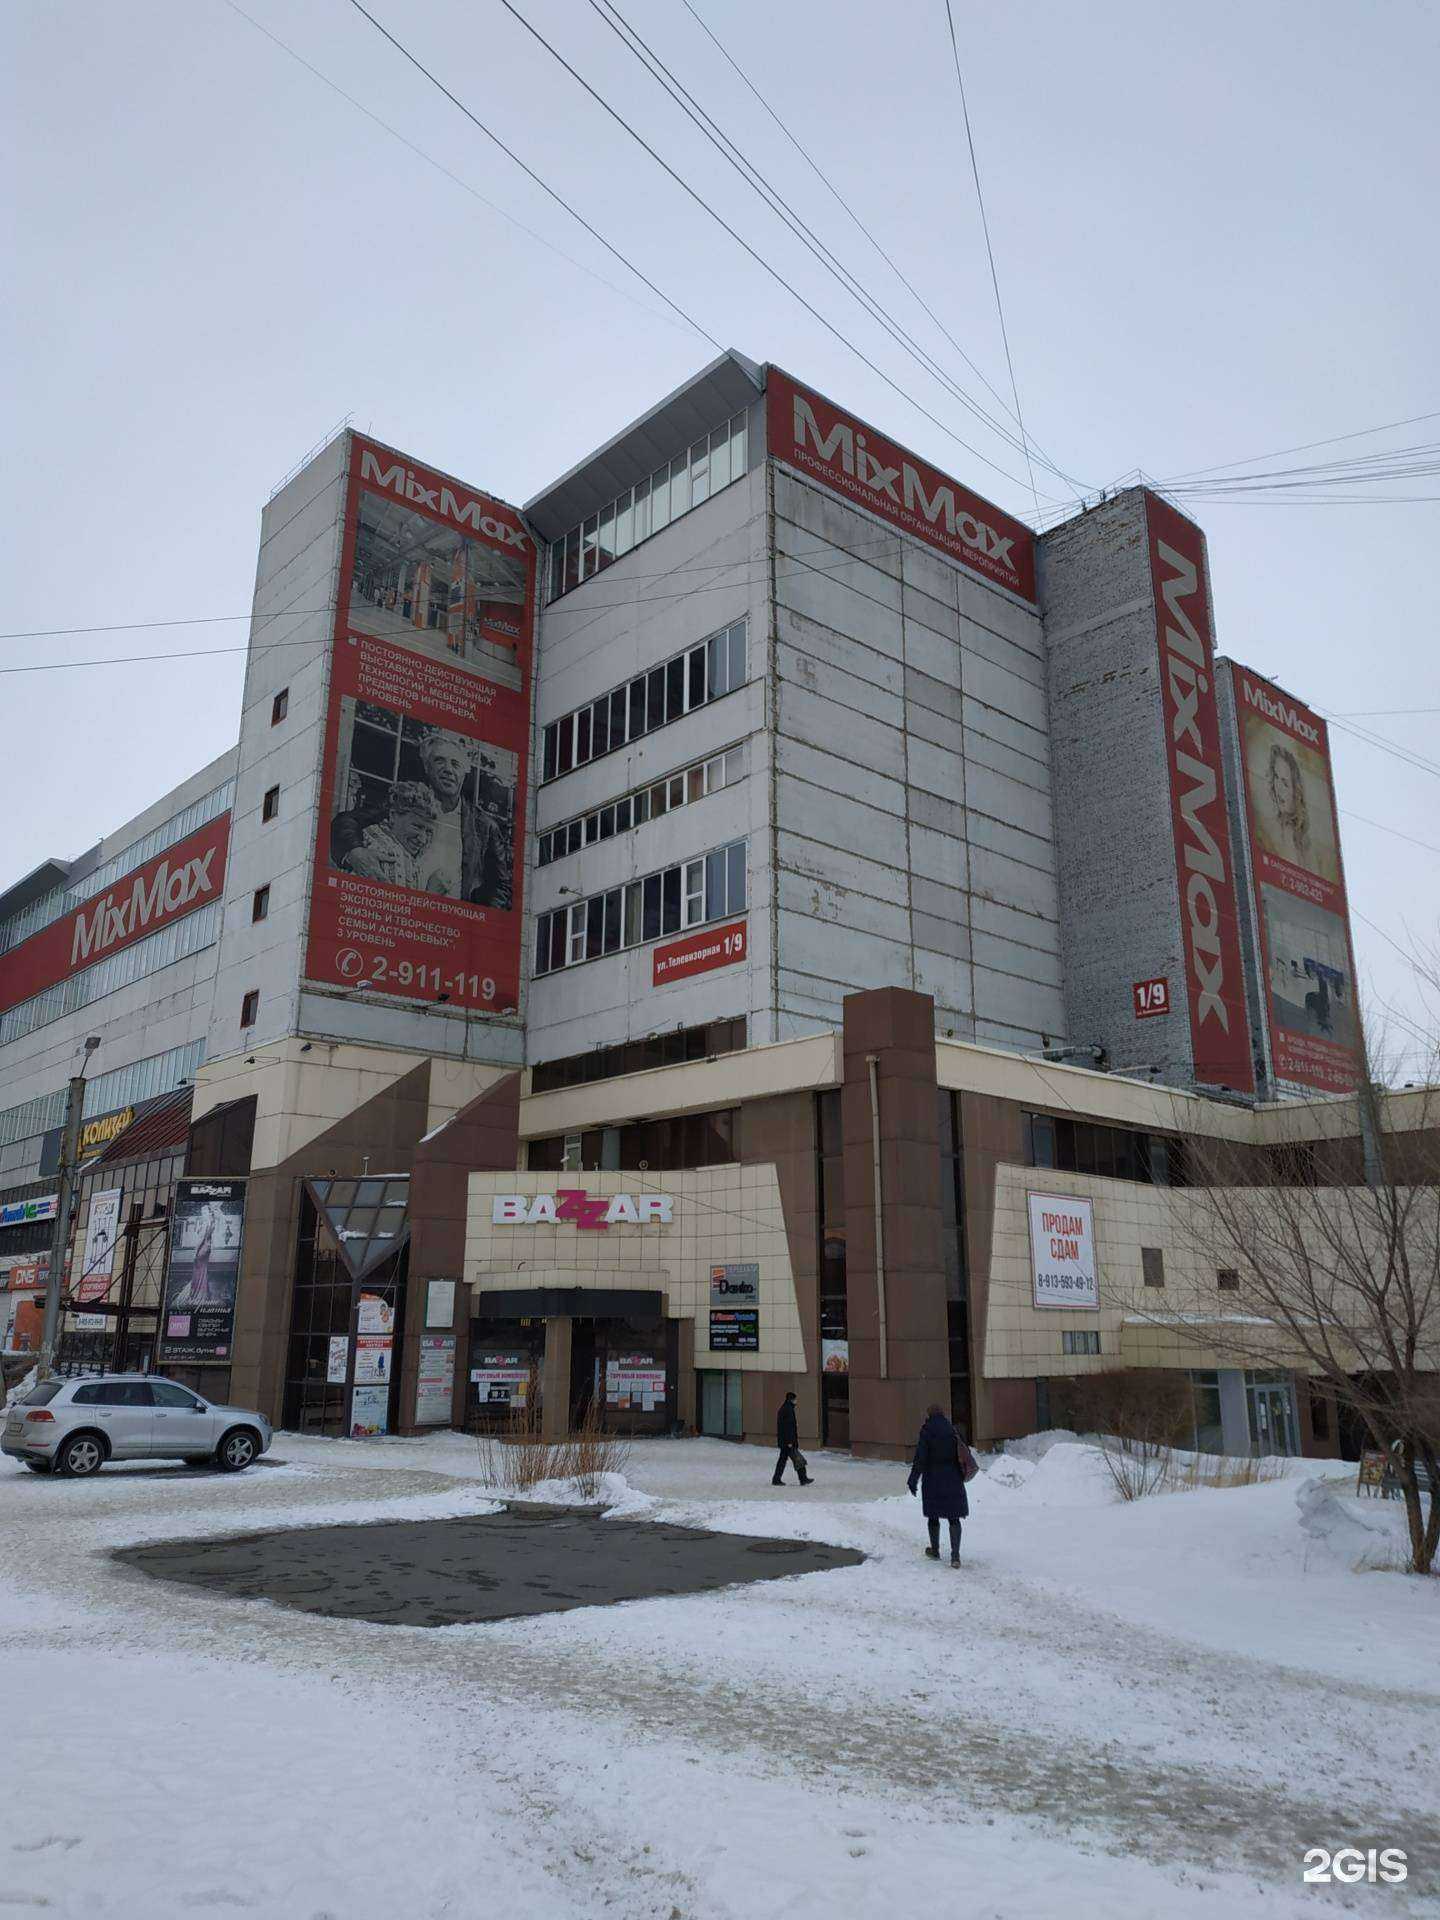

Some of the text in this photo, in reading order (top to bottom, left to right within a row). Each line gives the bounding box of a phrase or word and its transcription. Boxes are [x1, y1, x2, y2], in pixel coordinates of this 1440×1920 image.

[792, 394, 1017, 570] MixMax
[360, 450, 528, 551] MixMax
[793, 447, 899, 517] ПРОФЕССИОНАЛЬНАЯ
[900, 510, 961, 553] ОРГАНИЗАЦИЯ
[358, 672, 420, 701] ПРЕДМЕТОВ
[360, 651, 492, 707] ВЫСТАВКА СТРОИТЕЛЬНЫХ
[365, 685, 413, 710] УРОВЕНЬ
[429, 687, 468, 709] МЕБЕЛИ
[469, 702, 477, 711] И
[1242, 679, 1321, 744] MixMax
[1157, 538, 1230, 1036] MixMax
[70, 846, 217, 966] MixMax
[340, 892, 412, 915] ЭКСПОЗИЦИЯ
[336, 928, 397, 948] 3 УРОВЕНЬ
[337, 917, 377, 932] СЕМЬИ
[384, 913, 393, 923] И
[394, 915, 461, 938] ТВОРЧЕСТВО
[668, 943, 721, 968] Телевизорная
[723, 932, 743, 956] 1/9
[371, 956, 496, 1001] 2-911-119
[1137, 982, 1166, 1009] 1/9
[492, 1189, 674, 1230] BAZZAR
[1041, 1212, 1084, 1236] ПРОДАМ
[1050, 1237, 1080, 1261] СДАМ
